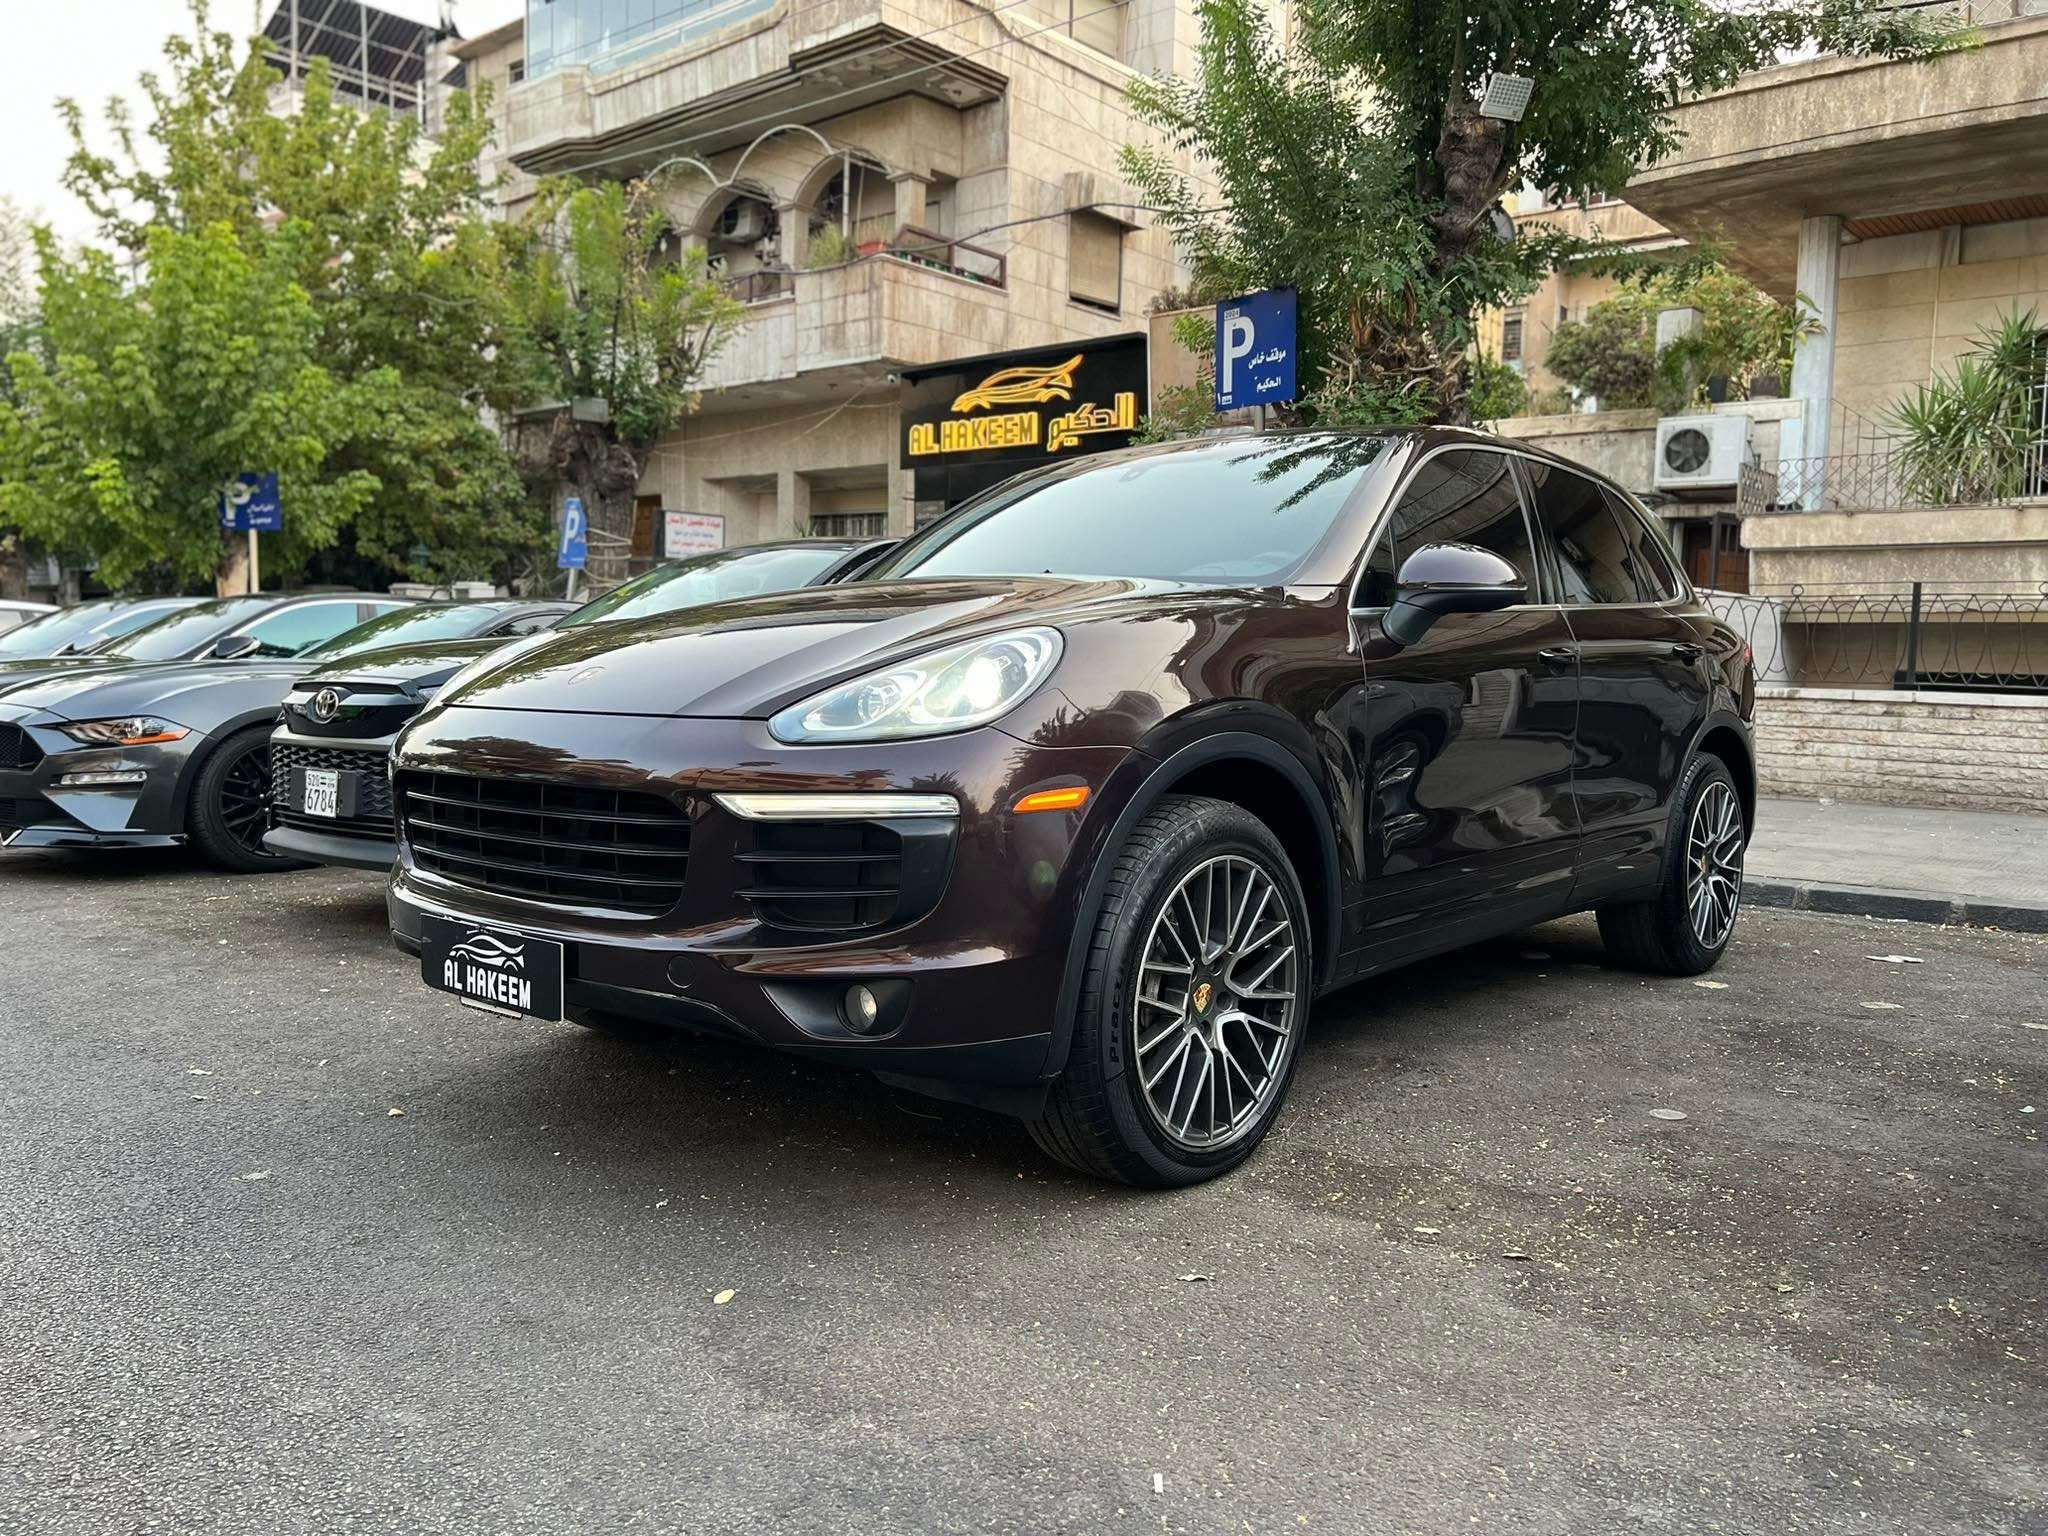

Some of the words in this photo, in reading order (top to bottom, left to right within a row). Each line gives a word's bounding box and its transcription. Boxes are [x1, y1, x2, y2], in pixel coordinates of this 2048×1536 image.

[1223, 316, 1255, 393] P
[1266, 347, 1286, 362] موقف
[1256, 376, 1281, 392] الحكيم
[909, 423, 940, 455] AL
[941, 411, 1038, 453] HAKEEM
[1047, 392, 1135, 452] الحكيم
[563, 509, 580, 554] P
[307, 788, 334, 814] 6784
[444, 959, 462, 990] AL
[466, 964, 531, 1010] HAKEEM
